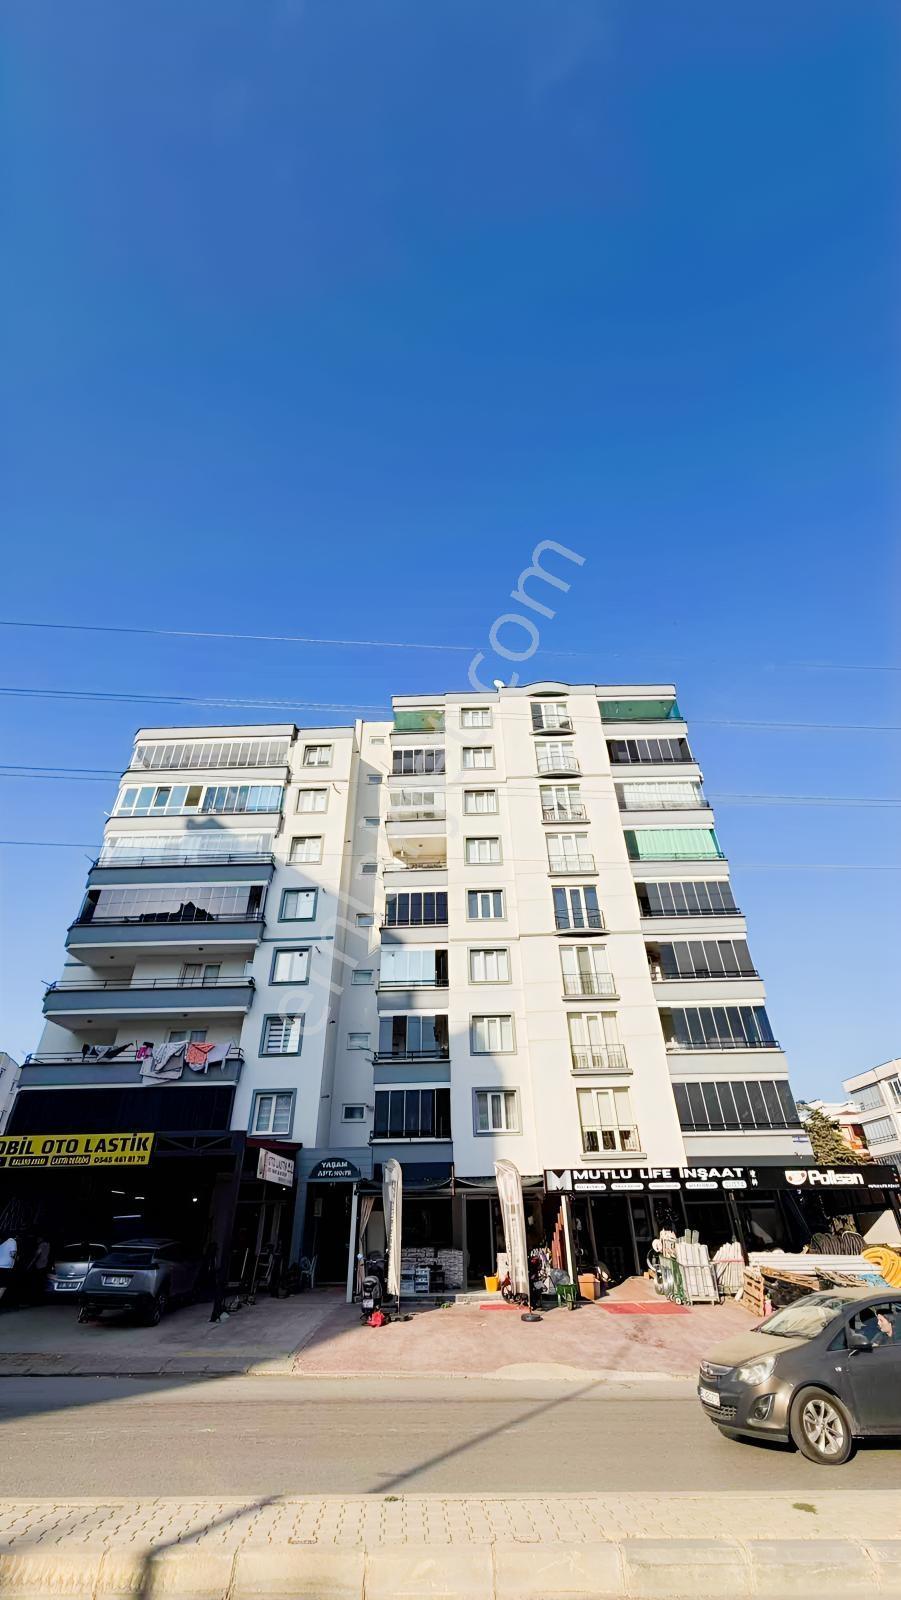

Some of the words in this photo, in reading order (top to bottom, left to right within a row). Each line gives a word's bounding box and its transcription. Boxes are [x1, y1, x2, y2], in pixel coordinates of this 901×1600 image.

[41, 1139, 79, 1154] OTO
[84, 1133, 150, 1153] LASTİK
[573, 1169, 633, 1180] MUTLU
[807, 1169, 865, 1185] Polisan
